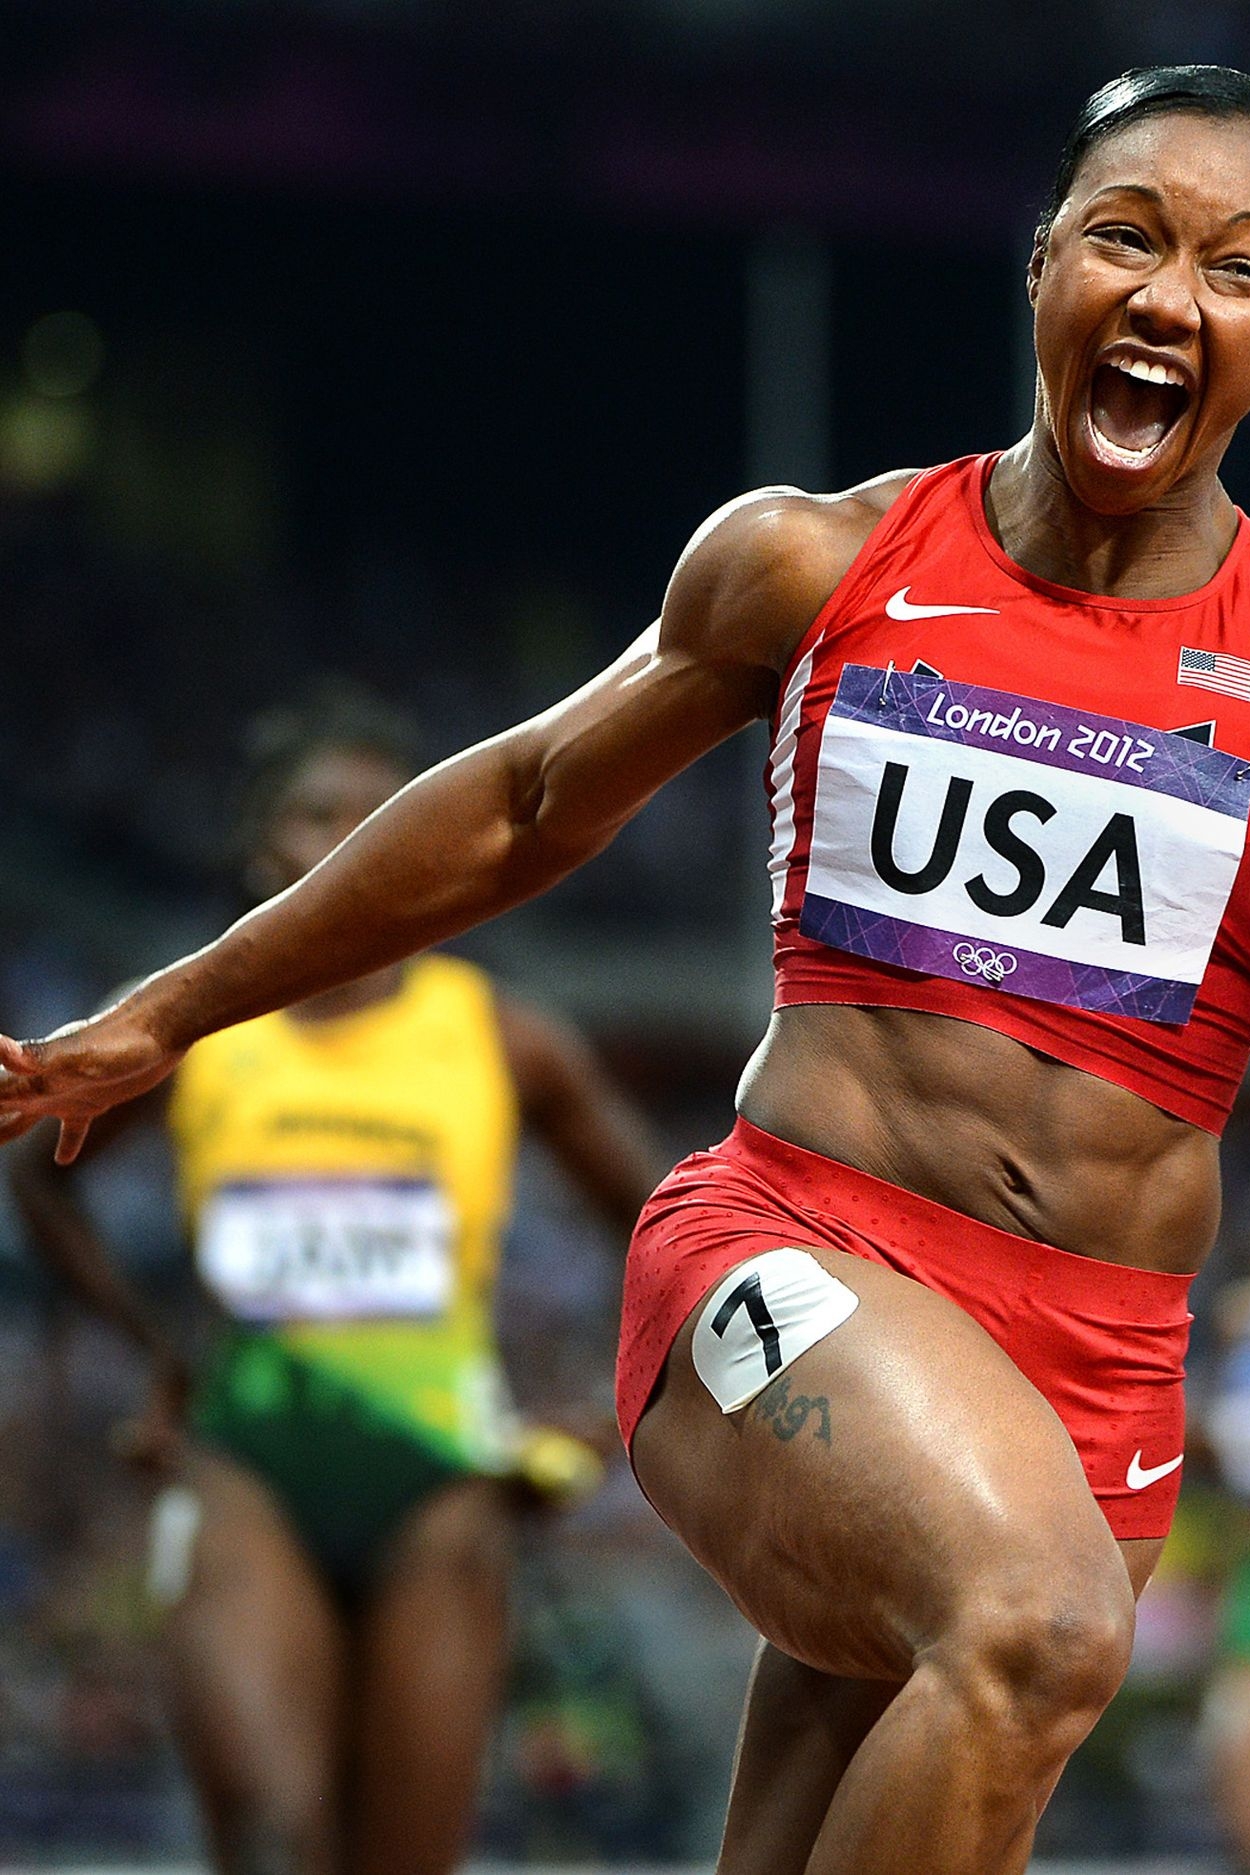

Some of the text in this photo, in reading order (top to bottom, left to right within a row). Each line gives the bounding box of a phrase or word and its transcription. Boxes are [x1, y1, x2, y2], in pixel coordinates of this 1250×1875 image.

[926, 692, 1156, 773] London 2012
[870, 762, 1146, 946] USA
[711, 1272, 783, 1377] 7
